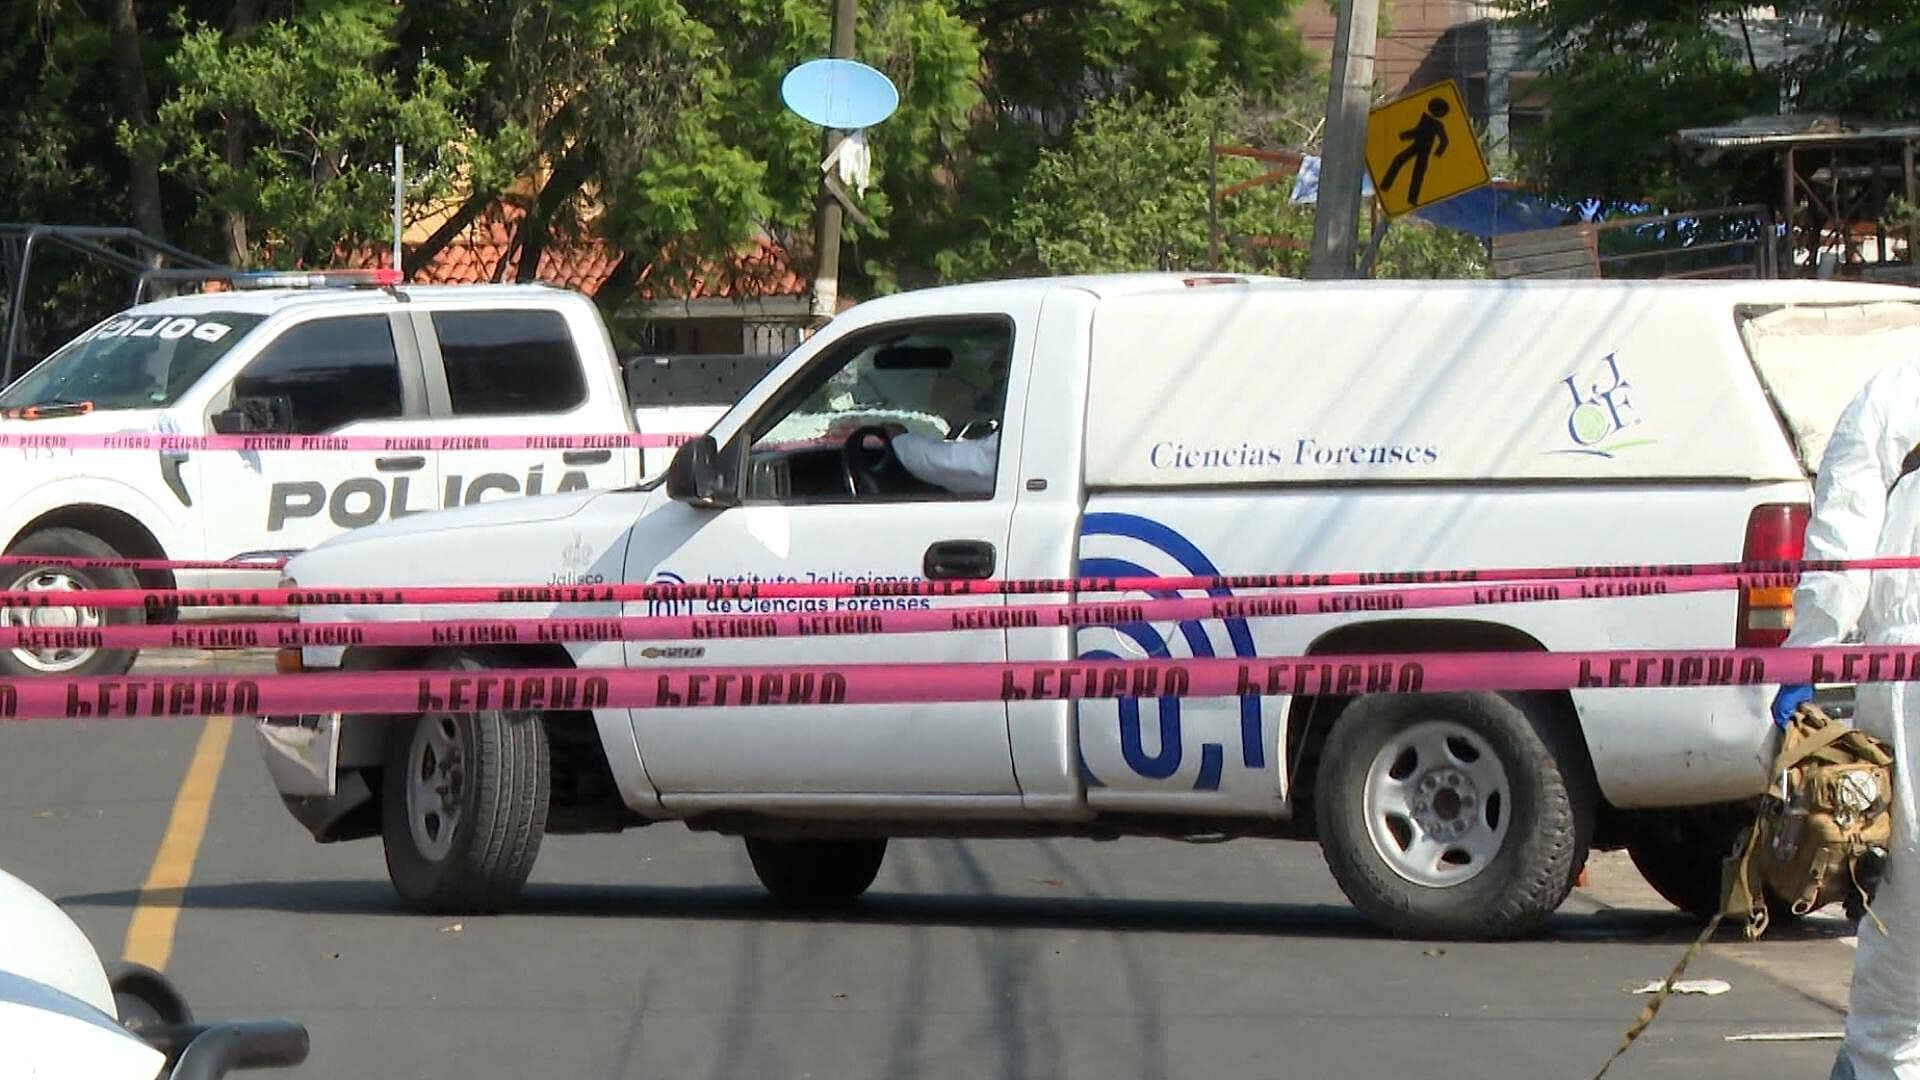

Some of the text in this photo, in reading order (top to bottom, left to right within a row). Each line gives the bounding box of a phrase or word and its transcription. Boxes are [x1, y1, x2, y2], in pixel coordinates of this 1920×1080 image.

[104, 437, 150, 448] PELIGRO
[160, 437, 207, 449] PELIGRO
[244, 437, 291, 449] PELIGRO
[301, 437, 349, 449] PELIGRO
[385, 438, 431, 449] PELIGRO
[442, 438, 489, 449] PELIGRO
[526, 437, 573, 448] PELIGRO
[584, 436, 631, 448] PELIGRO
[1150, 438, 1438, 470] Ciencias Forenses
[547, 571, 604, 585] Jalisco
[706, 597, 931, 612] de Ciencias Forenses
